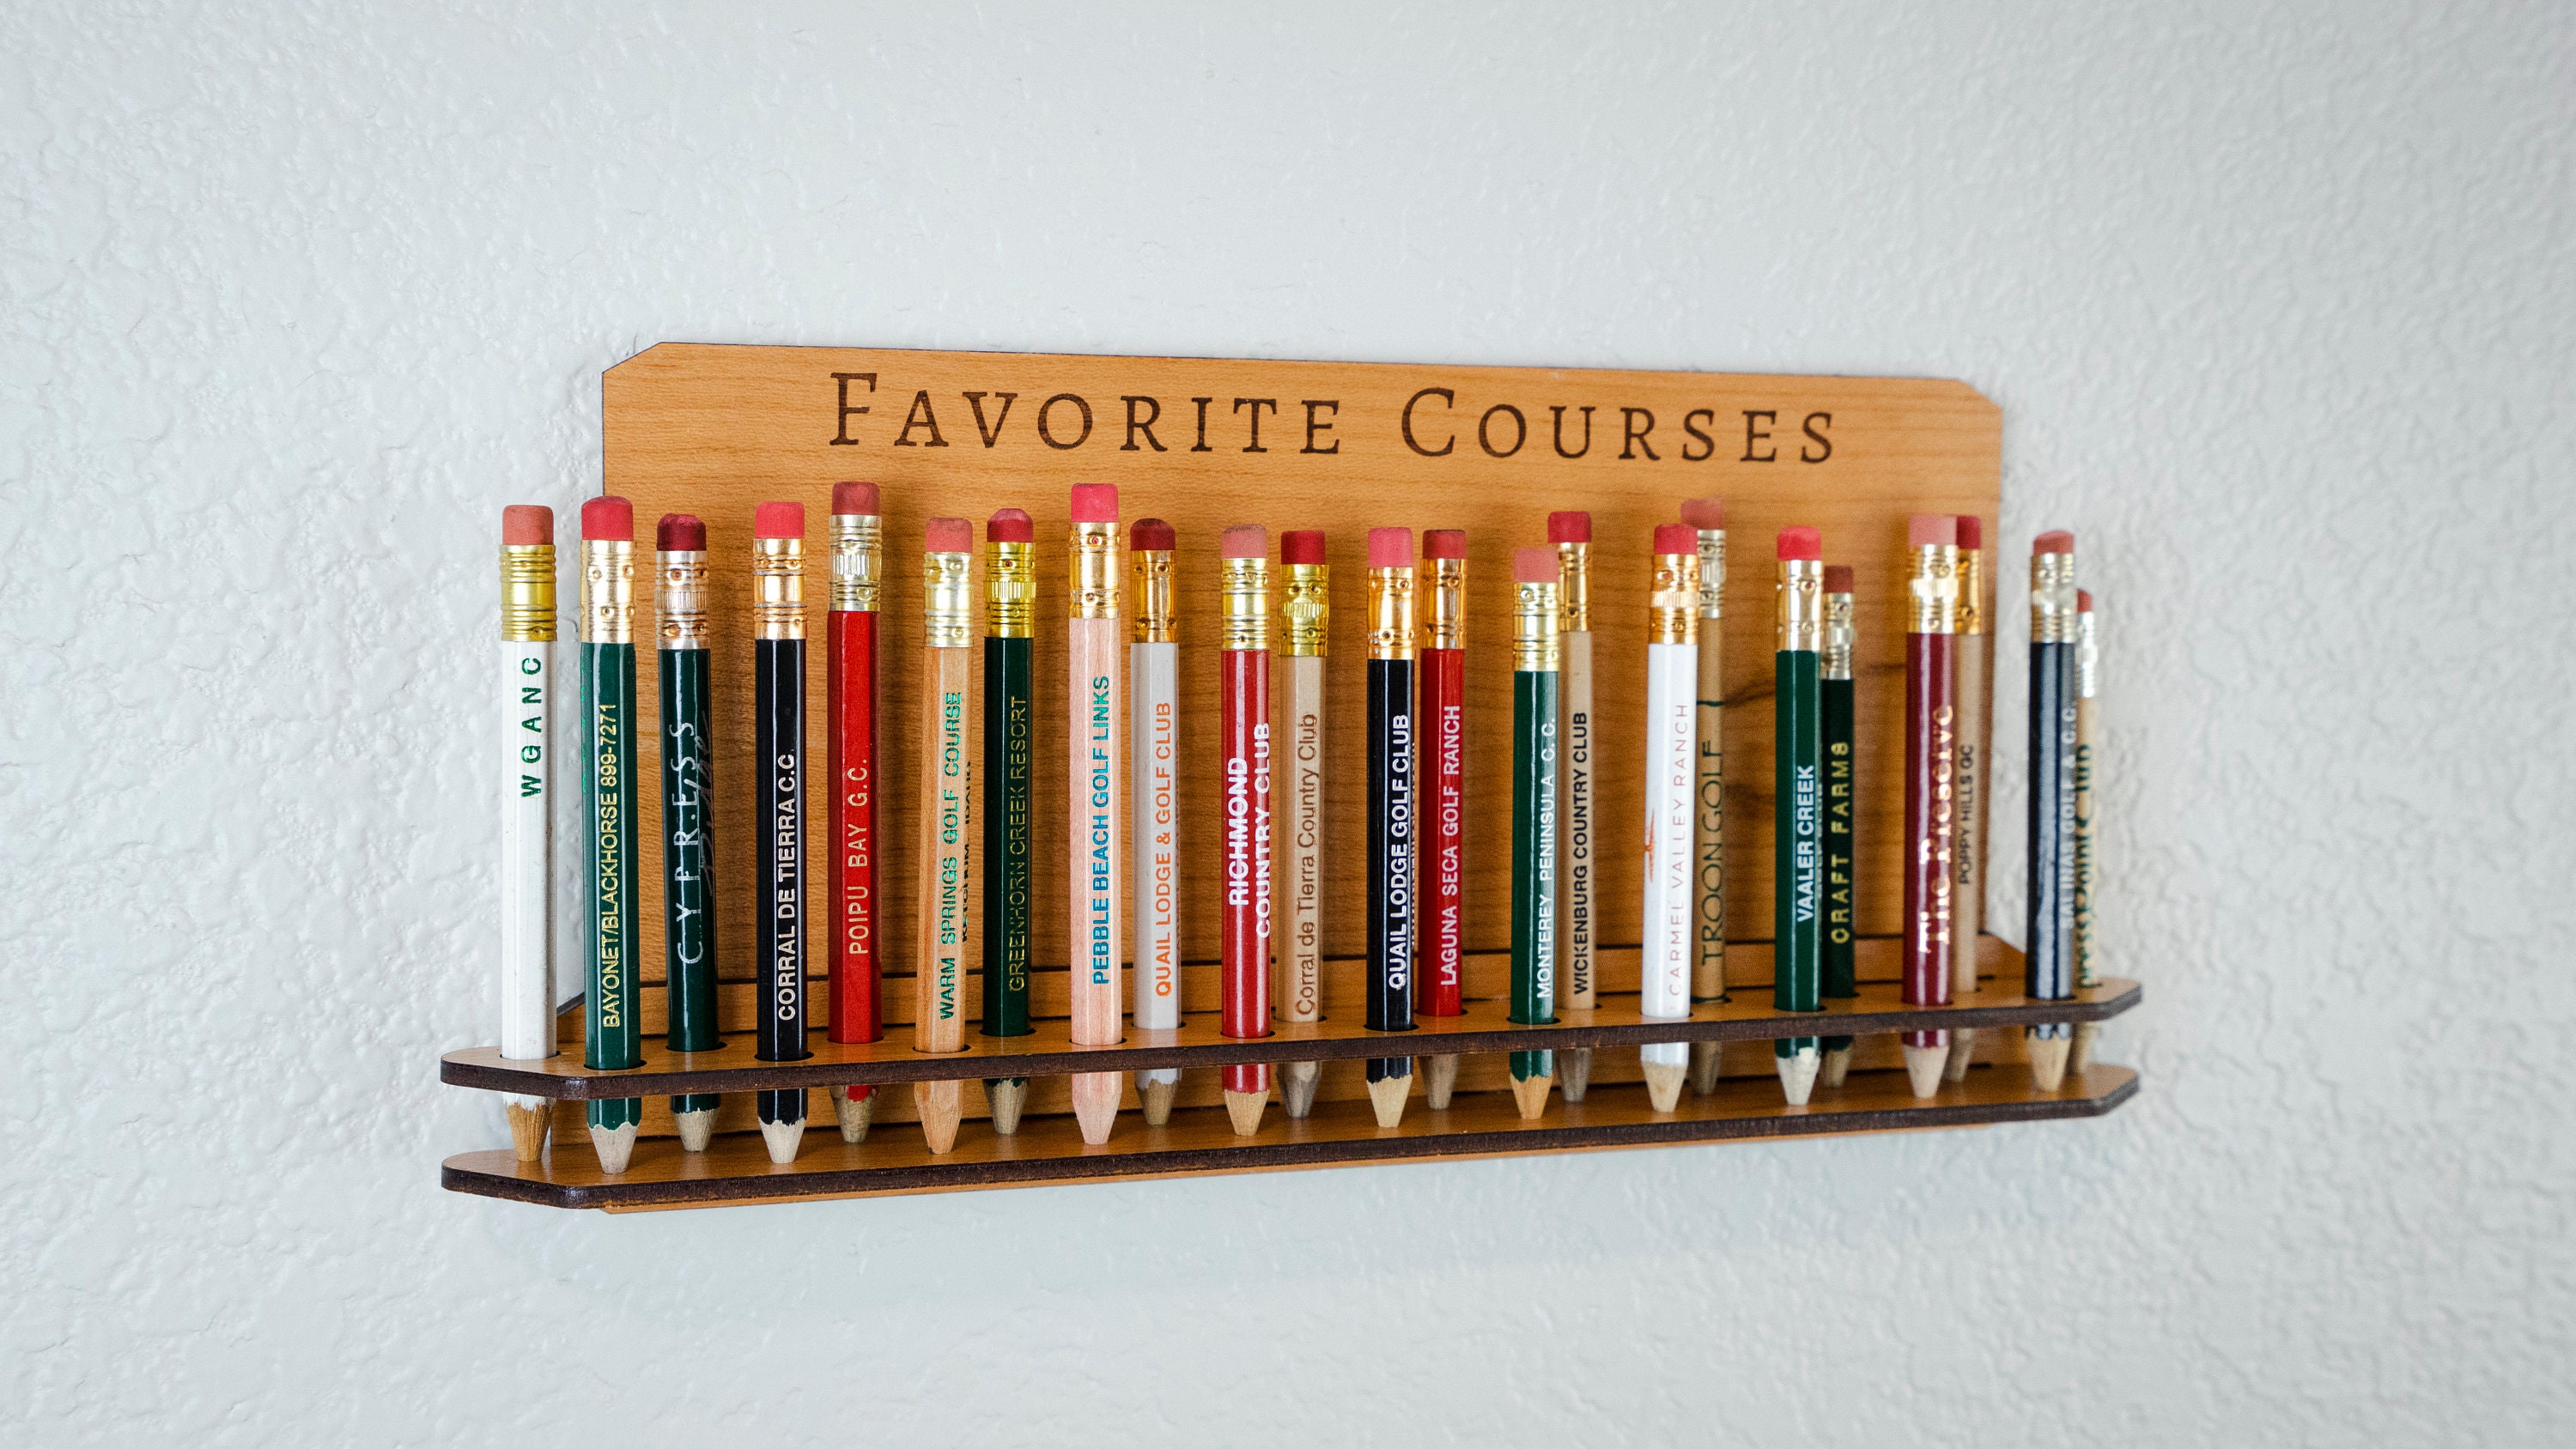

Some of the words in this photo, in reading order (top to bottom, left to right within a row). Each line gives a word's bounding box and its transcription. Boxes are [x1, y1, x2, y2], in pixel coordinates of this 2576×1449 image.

[829, 372, 1341, 455] FAVORITE
[1400, 386, 1835, 465] COURSES
[600, 704, 617, 787] 899-7271
[944, 692, 962, 778] COURSE
[1010, 695, 1027, 779] RESORT
[1092, 676, 1110, 741] LINKS
[1156, 702, 1172, 761] CLUB
[1297, 714, 1318, 761] Club
[1392, 713, 1410, 773] CLUB
[1443, 705, 1461, 775] RANCH
[1573, 712, 1589, 763] CLUB
[1674, 704, 1689, 787] RANCH
[848, 758, 868, 807] G.C.
[1092, 746, 1109, 809] GOLF
[1253, 722, 1271, 794] CLUB
[1702, 740, 1724, 834] GOLF
[1831, 742, 1850, 834] FARMS
[1918, 705, 1953, 865] Preserve
[943, 789, 960, 845] GOLF
[1009, 787, 1026, 855] CREEK
[1156, 767, 1171, 827] GOLF
[1228, 756, 1249, 907] RICHMOND
[1297, 769, 1320, 848] Country
[1391, 778, 1408, 838] GOLF
[1443, 786, 1460, 835] GOLF
[1539, 773, 1555, 882] PENINSULA
[1573, 770, 1589, 859] COUNTRY
[1797, 766, 1814, 835] CREEK
[1959, 775, 1973, 822] HILLS
[2061, 780, 2075, 834] GOLF
[669, 720, 702, 964] CYPRESS
[777, 799, 797, 884] TIERRA
[848, 823, 868, 869] BAY
[1092, 815, 1109, 890] BEACH
[1157, 831, 1171, 845] &
[1255, 808, 1271, 939] COUNTRY
[1441, 844, 1459, 896] SECA
[1671, 798, 1686, 889] VALLEY
[1958, 829, 1973, 885] POPPY
[602, 791, 621, 1028] BAYONET/BLACKHORSE
[777, 888, 796, 920] DE
[941, 857, 957, 945] SPRINGS
[1156, 853, 1171, 925] LODGE
[1297, 856, 1317, 915] Tierra
[1389, 844, 1408, 919] LODGE
[1702, 842, 1724, 967] TROON
[1796, 841, 1814, 923] VAALER
[1831, 853, 1850, 944] CRAFT
[1918, 875, 1952, 954] The
[2060, 841, 2075, 929] SALINAS
[848, 885, 869, 955] POIPU
[1008, 863, 1025, 991] GREENHORN
[1092, 898, 1109, 985] PEBBLE
[1297, 922, 1316, 946] de
[1388, 921, 1406, 991] QUAIL
[1440, 905, 1458, 986] LAGUNA
[1536, 894, 1552, 999] MONTEREY
[1574, 864, 1589, 996] WICKENBURG
[1669, 900, 1685, 997] CARMEL
[778, 925, 797, 1022] CORRAL
[939, 957, 957, 1021] WARM
[1156, 929, 1173, 997] QUAIL
[1296, 954, 1316, 1016] Corral
